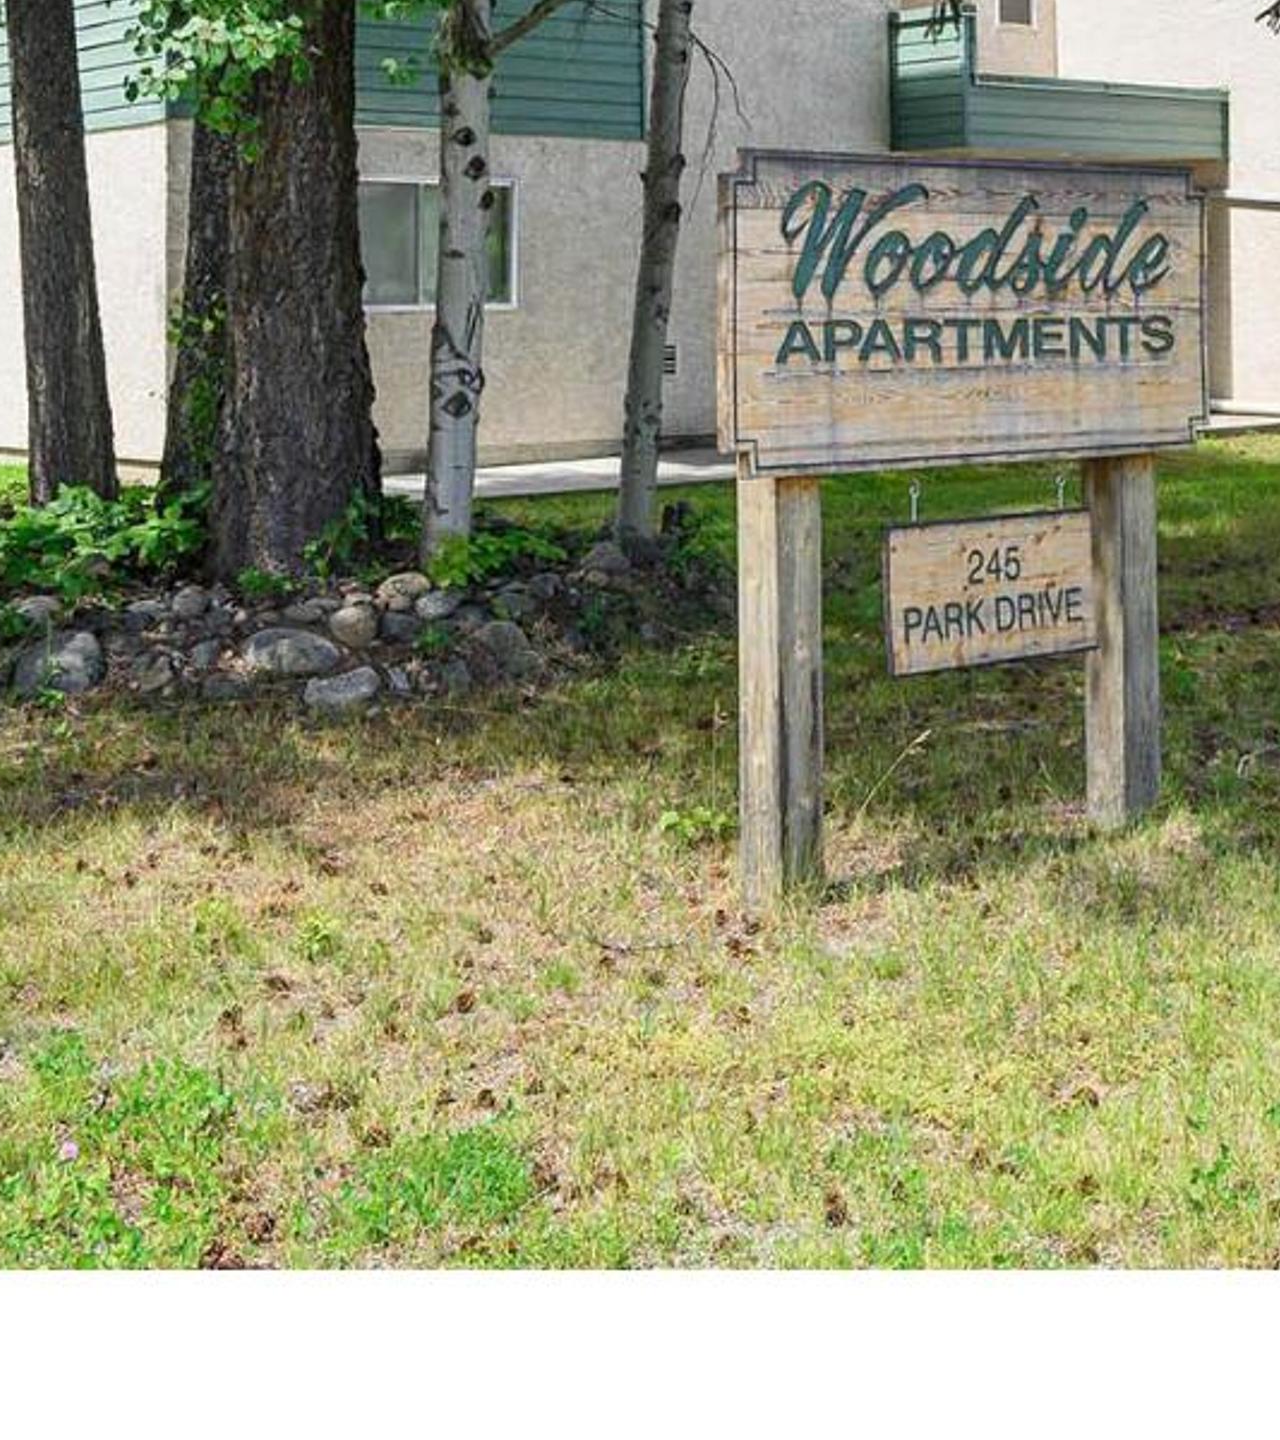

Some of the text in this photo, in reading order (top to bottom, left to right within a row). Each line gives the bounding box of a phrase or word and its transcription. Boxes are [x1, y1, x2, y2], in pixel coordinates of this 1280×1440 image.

[781, 181, 1169, 299] Woodside
[775, 316, 1174, 364] APARTMENTS
[967, 547, 1021, 585] 245
[904, 587, 1084, 644] PARK DRIVE
